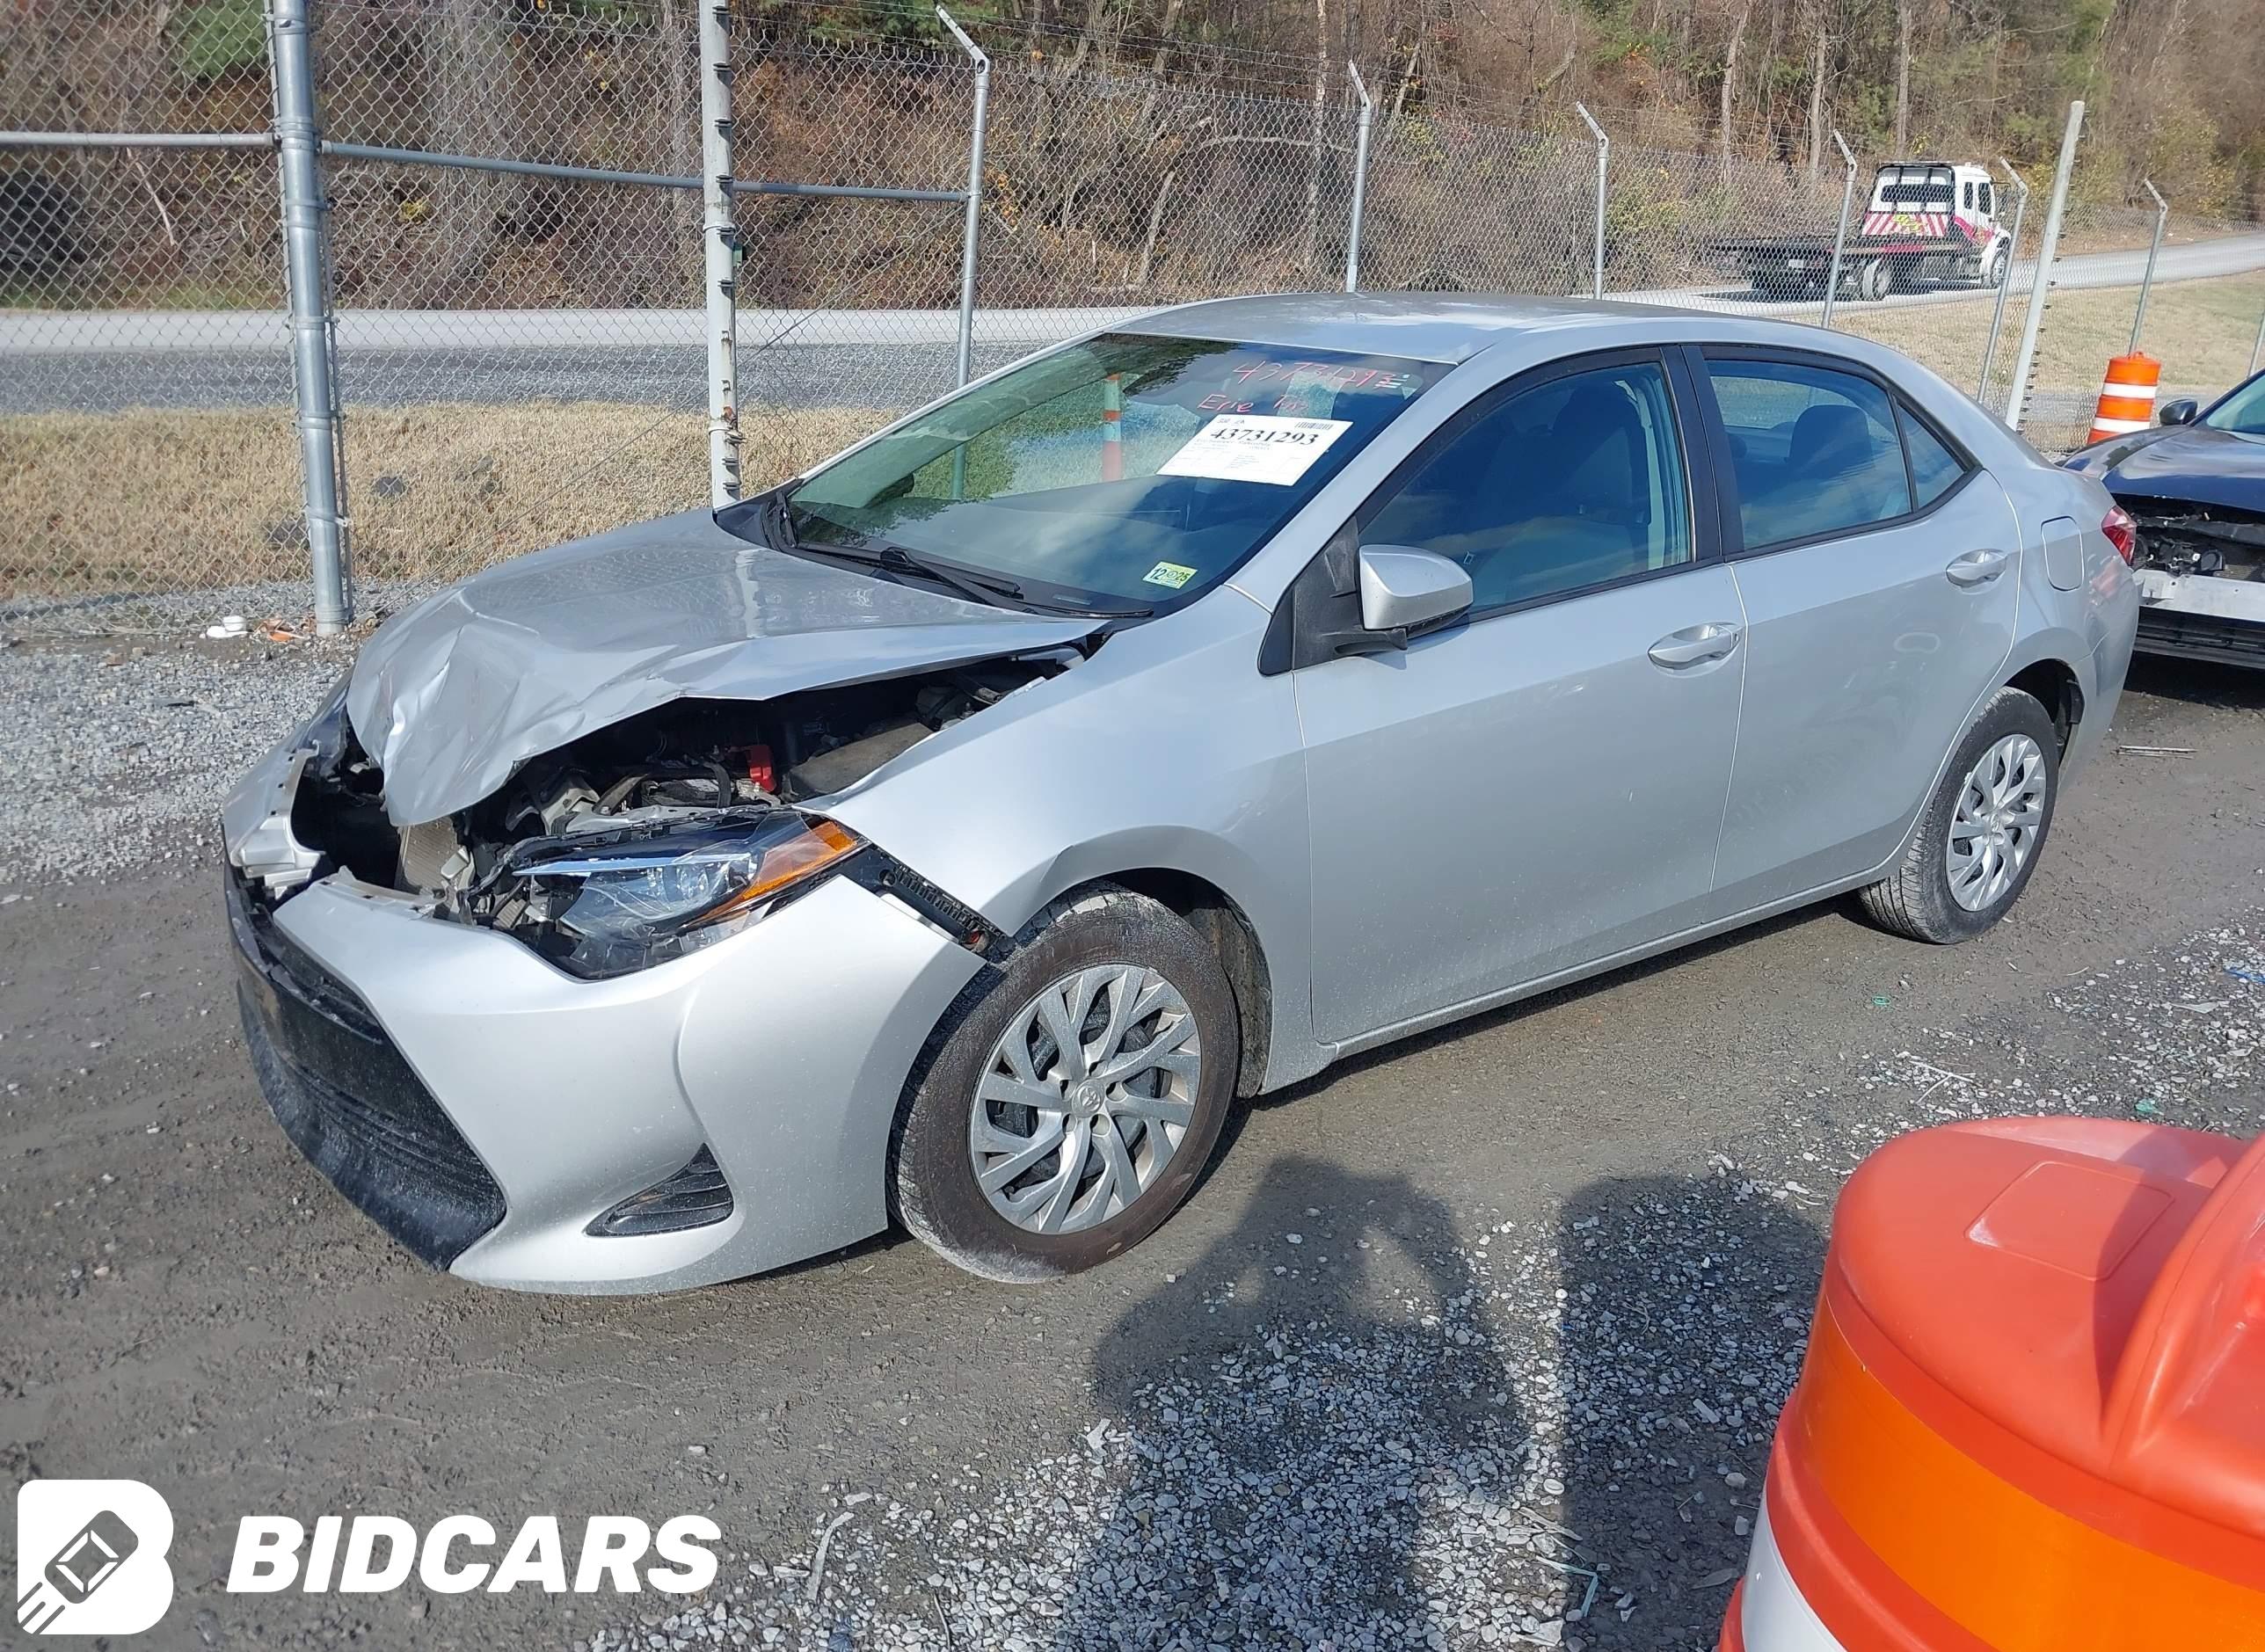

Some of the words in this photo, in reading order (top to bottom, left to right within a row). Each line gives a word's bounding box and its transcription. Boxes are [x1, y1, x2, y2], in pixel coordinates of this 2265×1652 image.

[1197, 393, 1254, 412] Erie
[1210, 428, 1319, 446] 43731293
[1150, 567, 1168, 580] 12
[1176, 571, 1191, 582] 25
